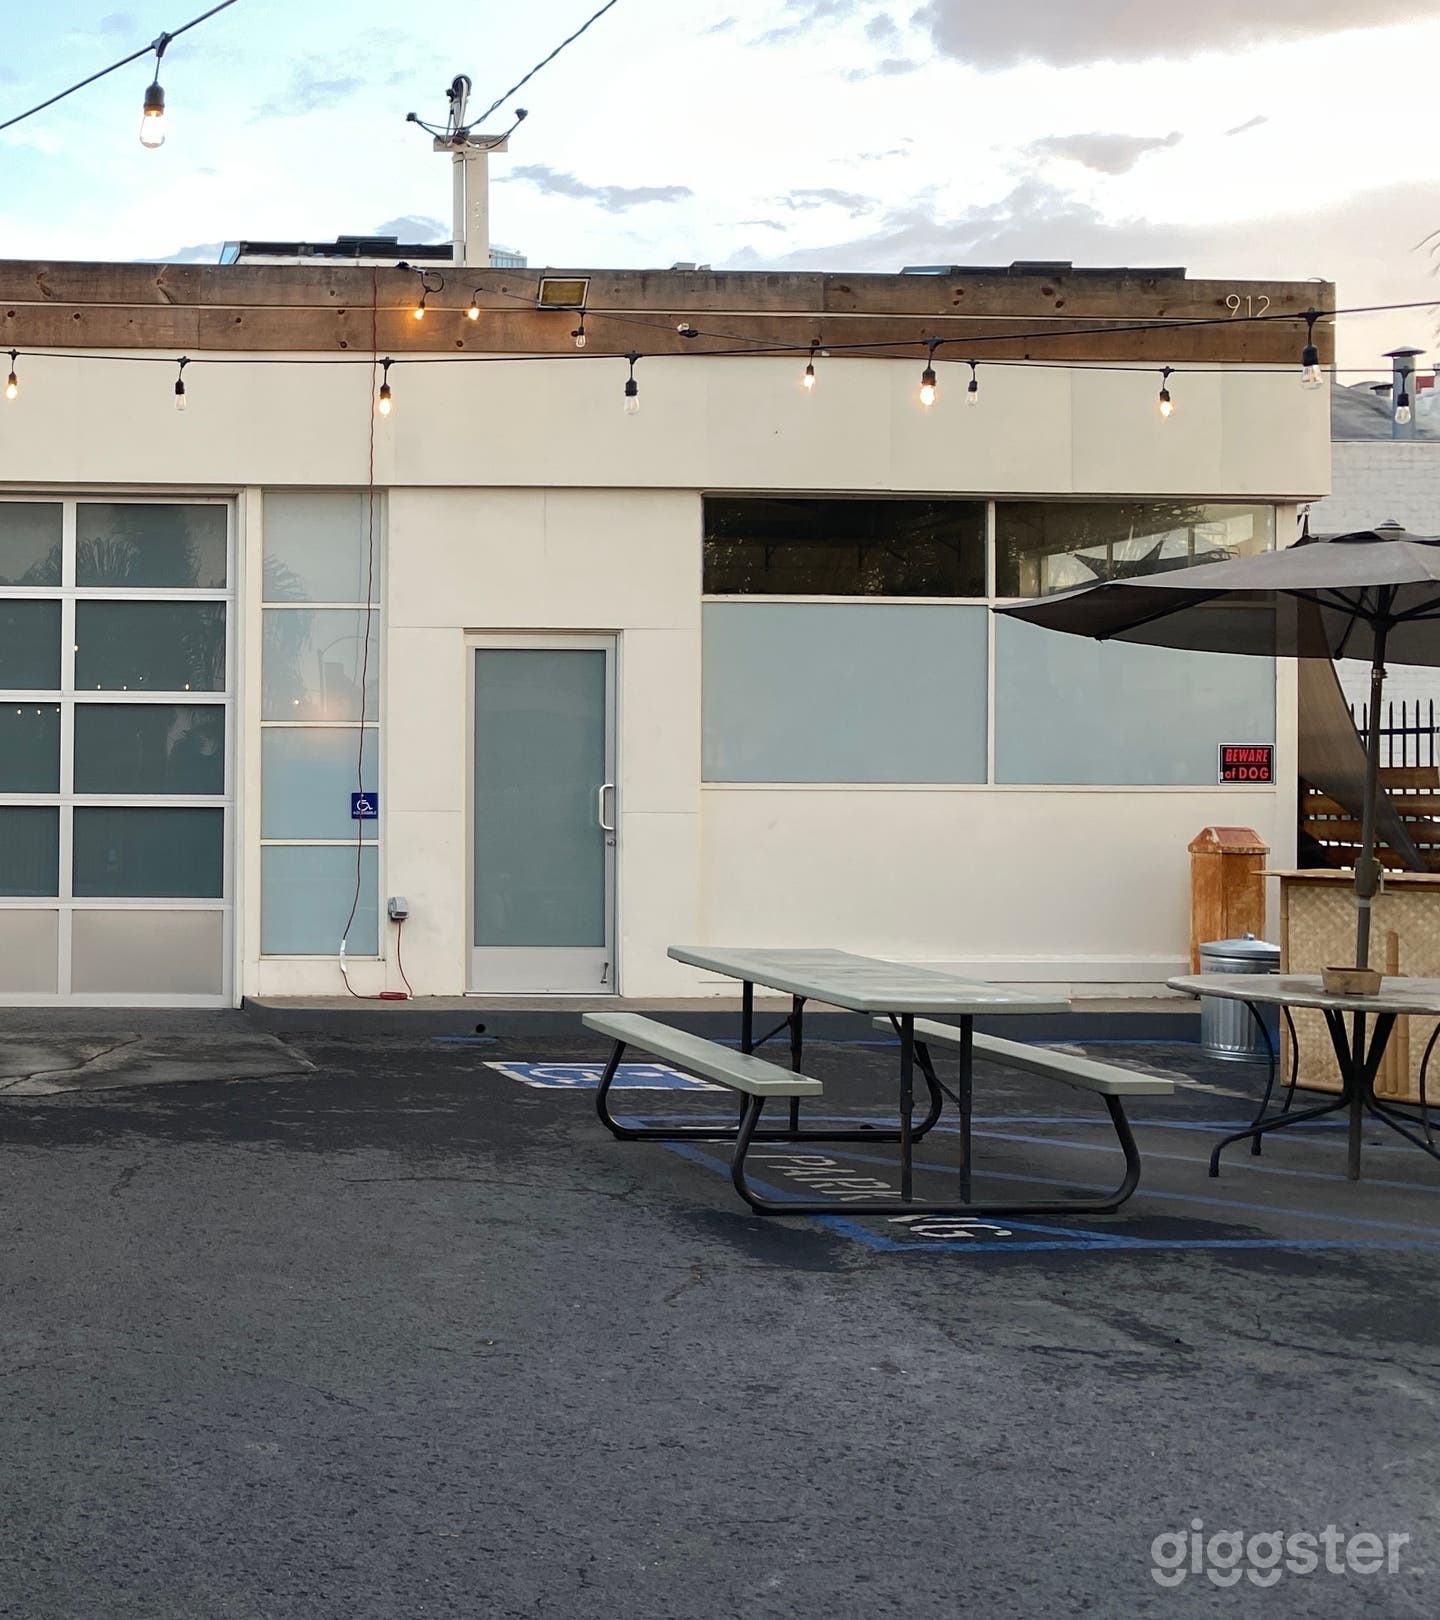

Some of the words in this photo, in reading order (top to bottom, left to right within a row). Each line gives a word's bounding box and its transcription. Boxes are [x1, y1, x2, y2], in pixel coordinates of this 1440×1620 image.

[1225, 294, 1270, 319] 912
[1225, 748, 1269, 762] BEWARE
[1224, 767, 1236, 779] of
[1239, 767, 1269, 779] DOG
